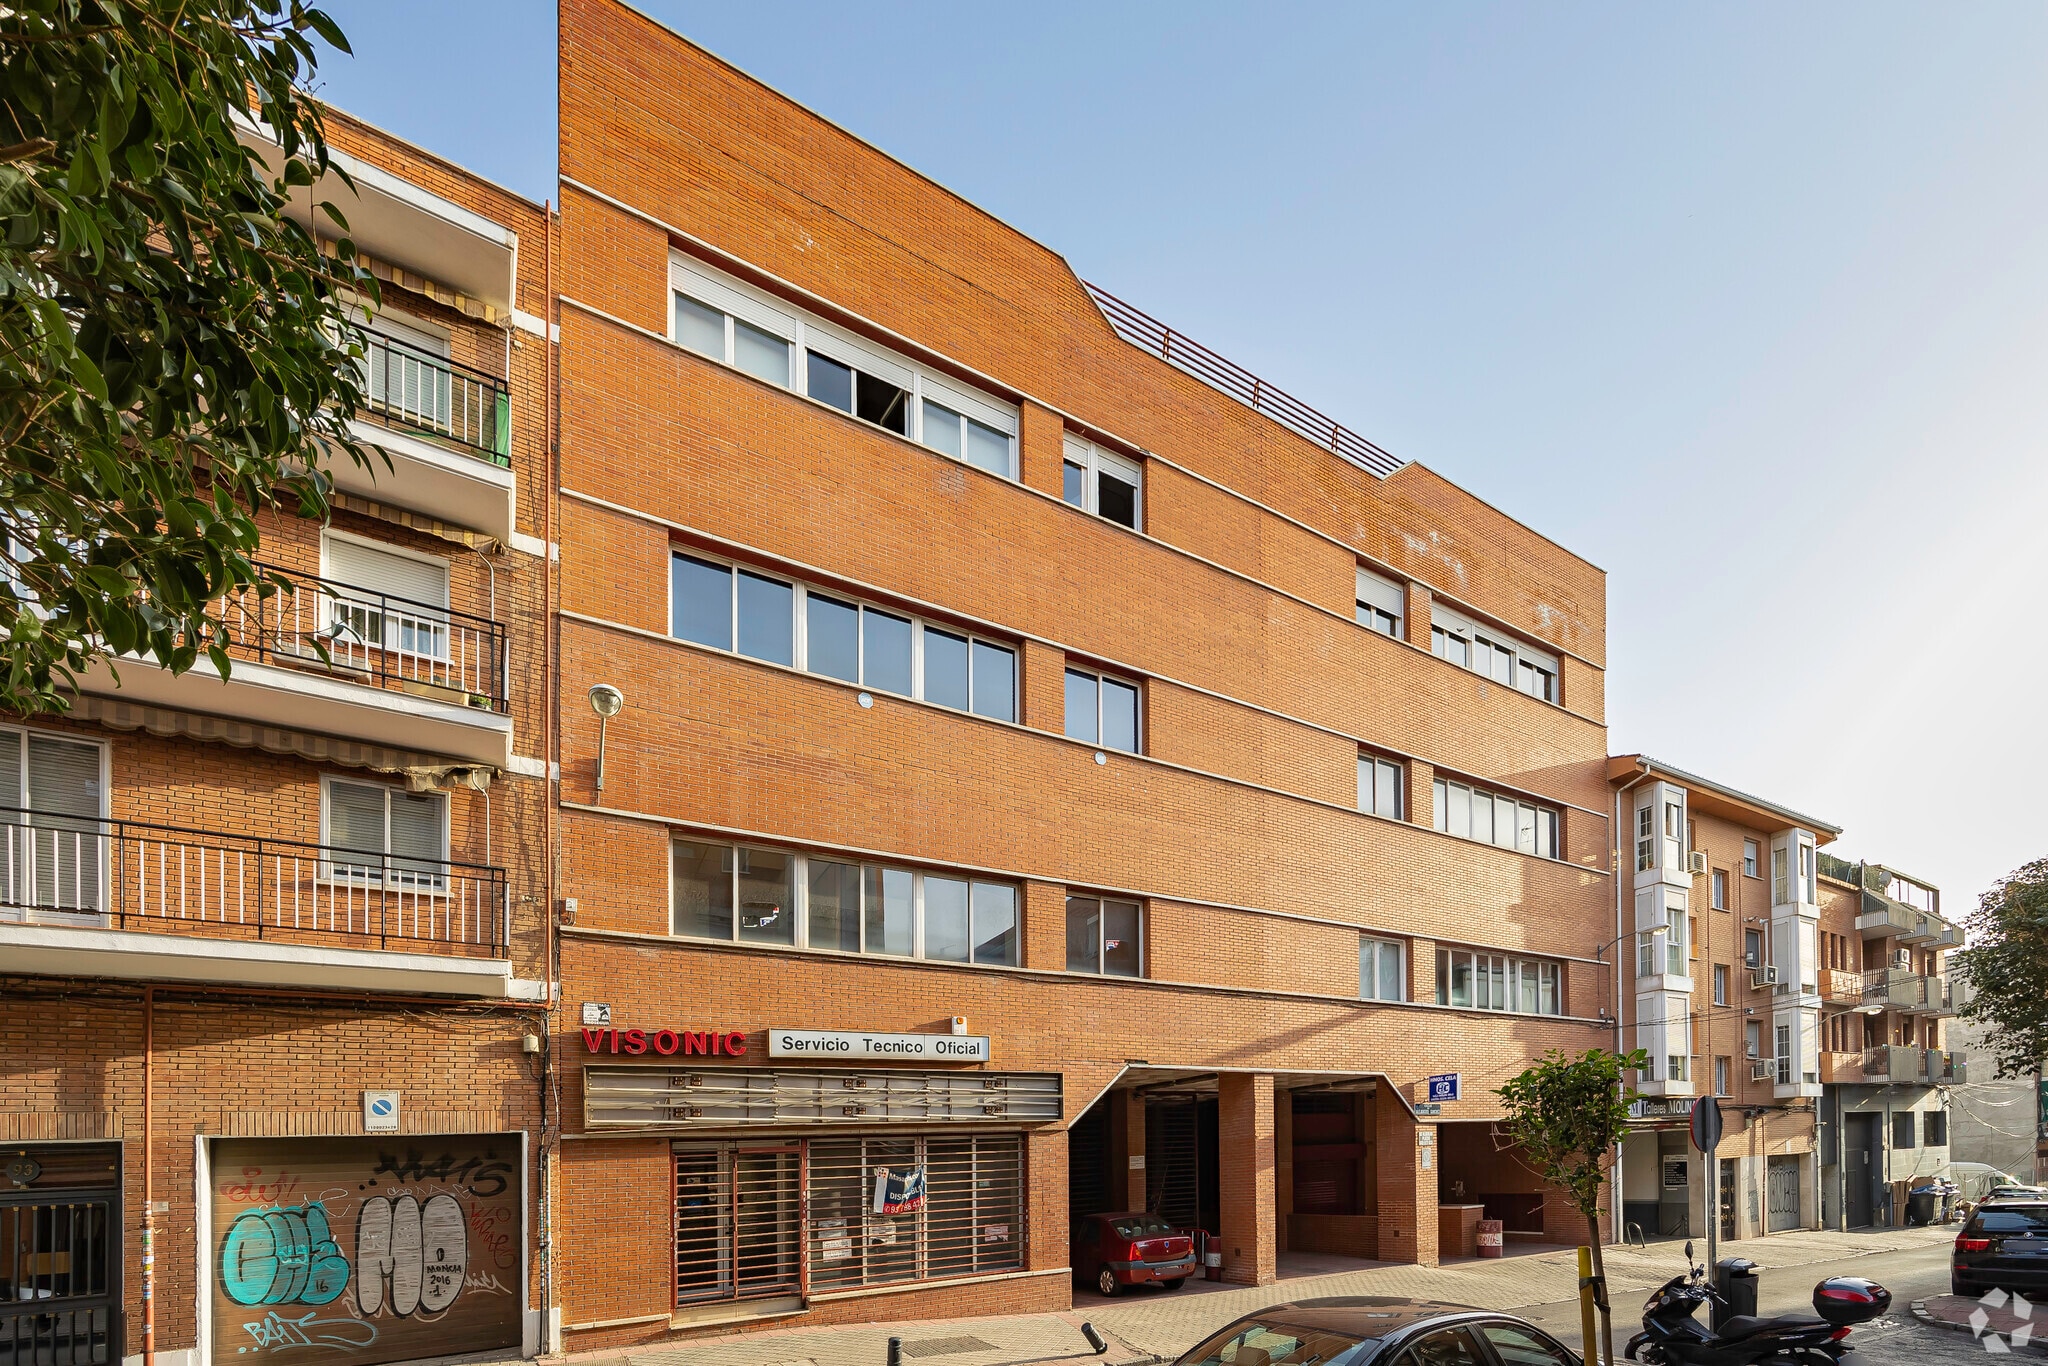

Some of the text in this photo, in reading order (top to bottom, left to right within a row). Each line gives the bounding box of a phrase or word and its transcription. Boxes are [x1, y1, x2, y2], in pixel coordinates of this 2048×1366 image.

[581, 1028, 747, 1056] VISONIC
[782, 1035, 980, 1055] Servicio Tecnico Oficial
[1642, 1101, 1667, 1115] Talleres
[14, 1164, 33, 1176] 93
[315, 1279, 329, 1293] 16
[430, 1275, 451, 1285] 2016
